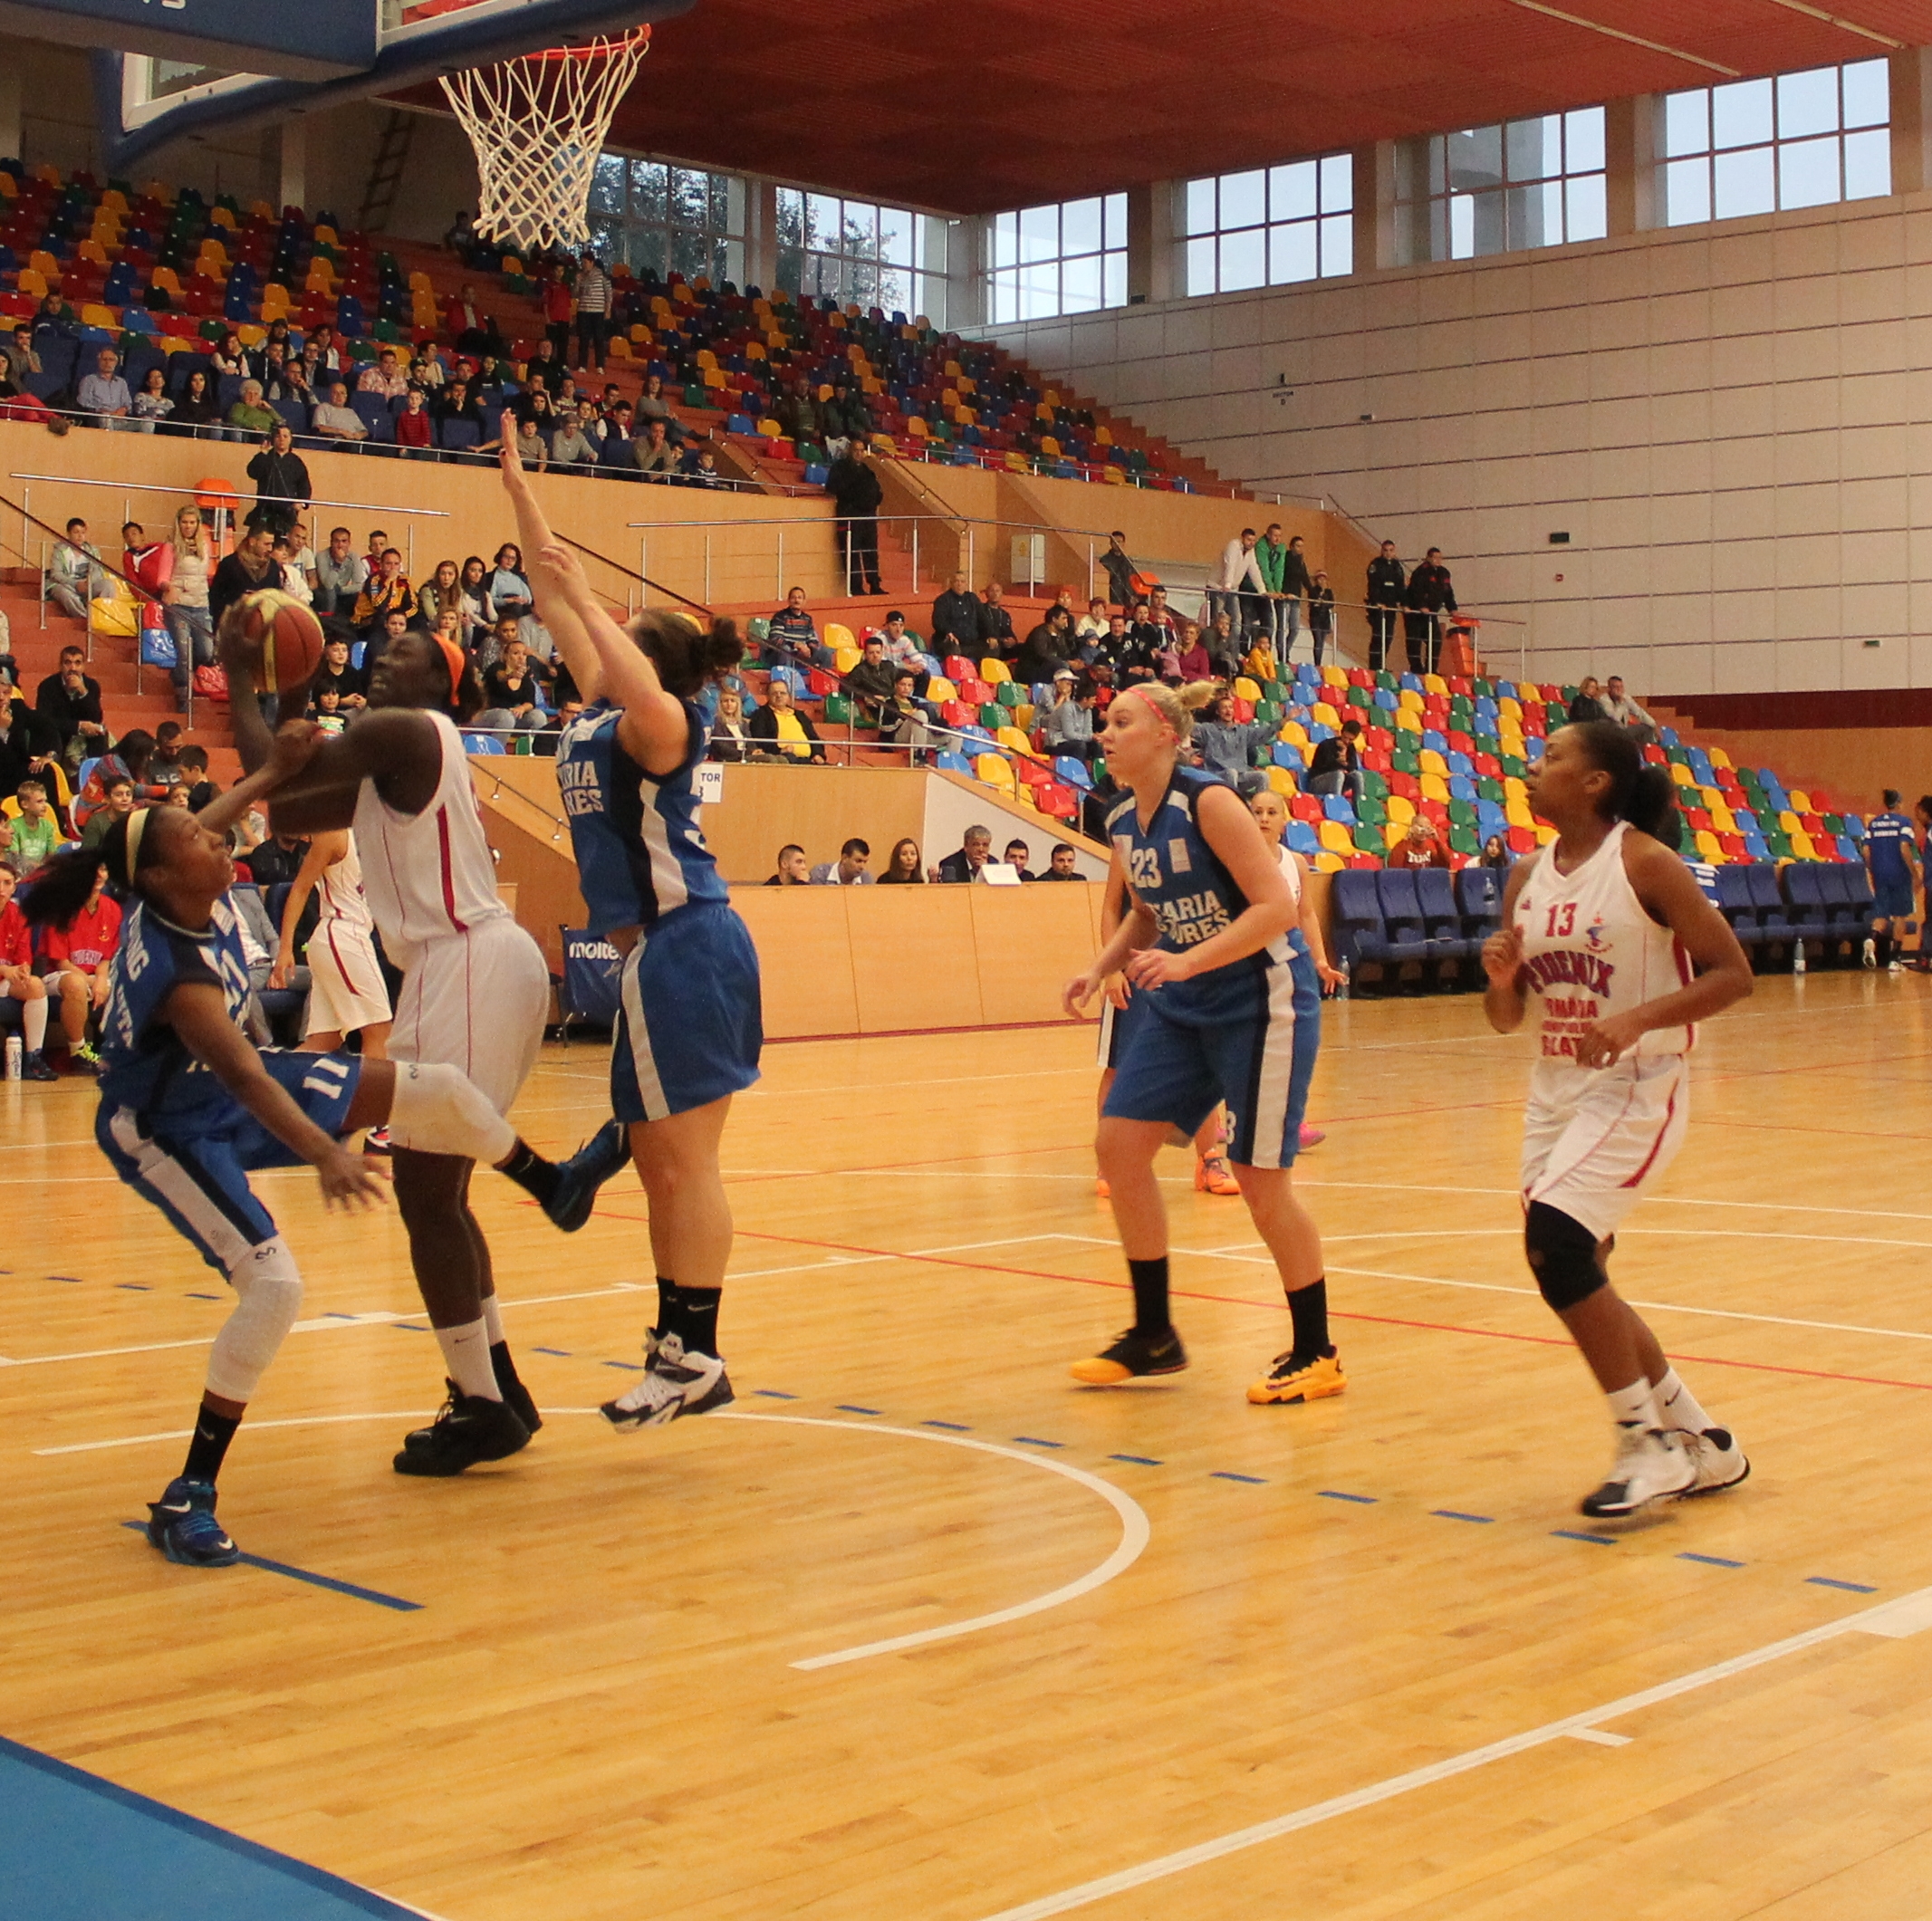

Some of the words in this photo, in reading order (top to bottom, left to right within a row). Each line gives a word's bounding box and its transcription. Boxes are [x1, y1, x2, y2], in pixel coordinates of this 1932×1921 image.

[701, 773, 721, 783] TOR
[1132, 847, 1163, 888] 23
[1146, 890, 1221, 924] ARIA
[1545, 902, 1578, 937] 13
[569, 942, 622, 959] molte
